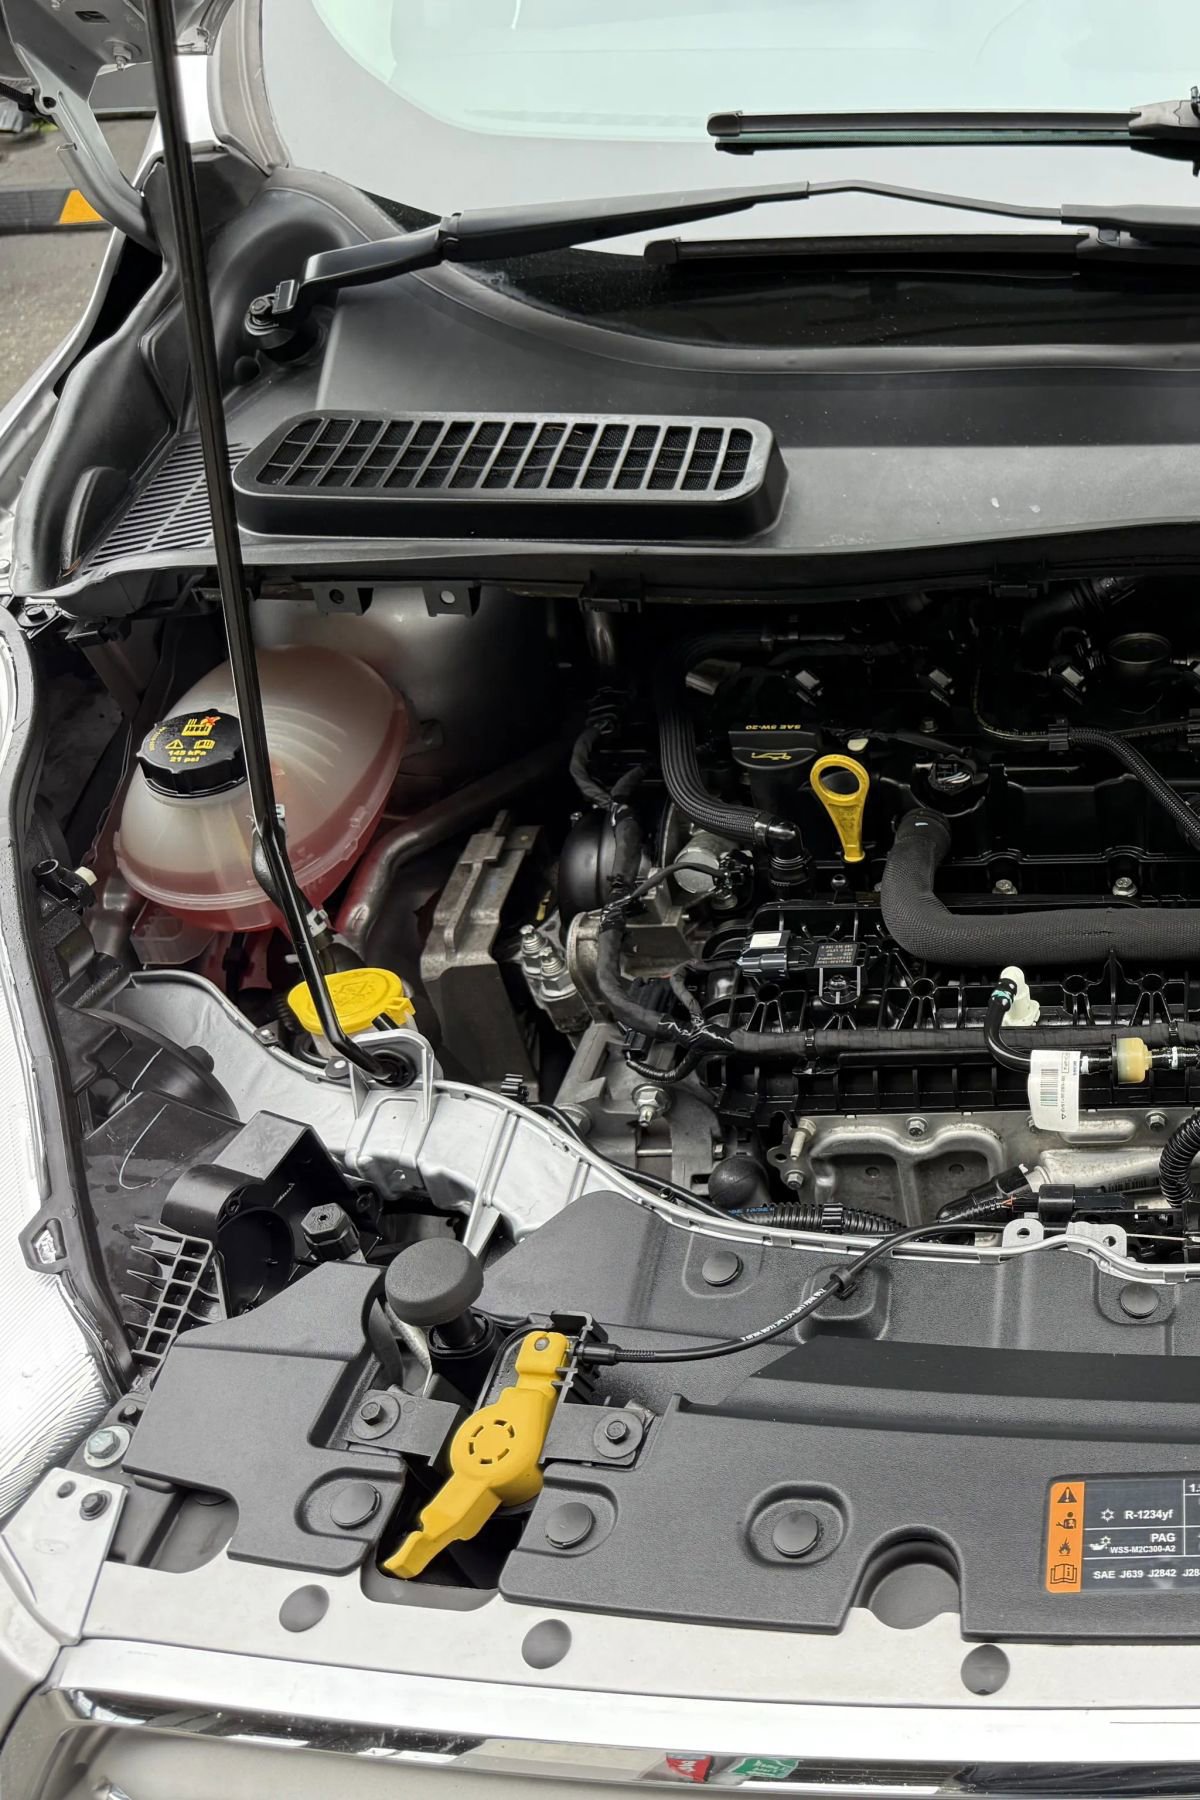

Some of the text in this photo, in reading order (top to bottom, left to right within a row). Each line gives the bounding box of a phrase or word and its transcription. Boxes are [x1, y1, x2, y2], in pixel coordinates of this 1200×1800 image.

[1124, 1508, 1175, 1521] R-1234yf
[1150, 1532, 1176, 1543] PAG
[1110, 1545, 1176, 1554] WSS-M2C300-A2
[1092, 1570, 1116, 1579] SAE
[1119, 1569, 1144, 1578] J639
[1147, 1568, 1177, 1578] J2842
